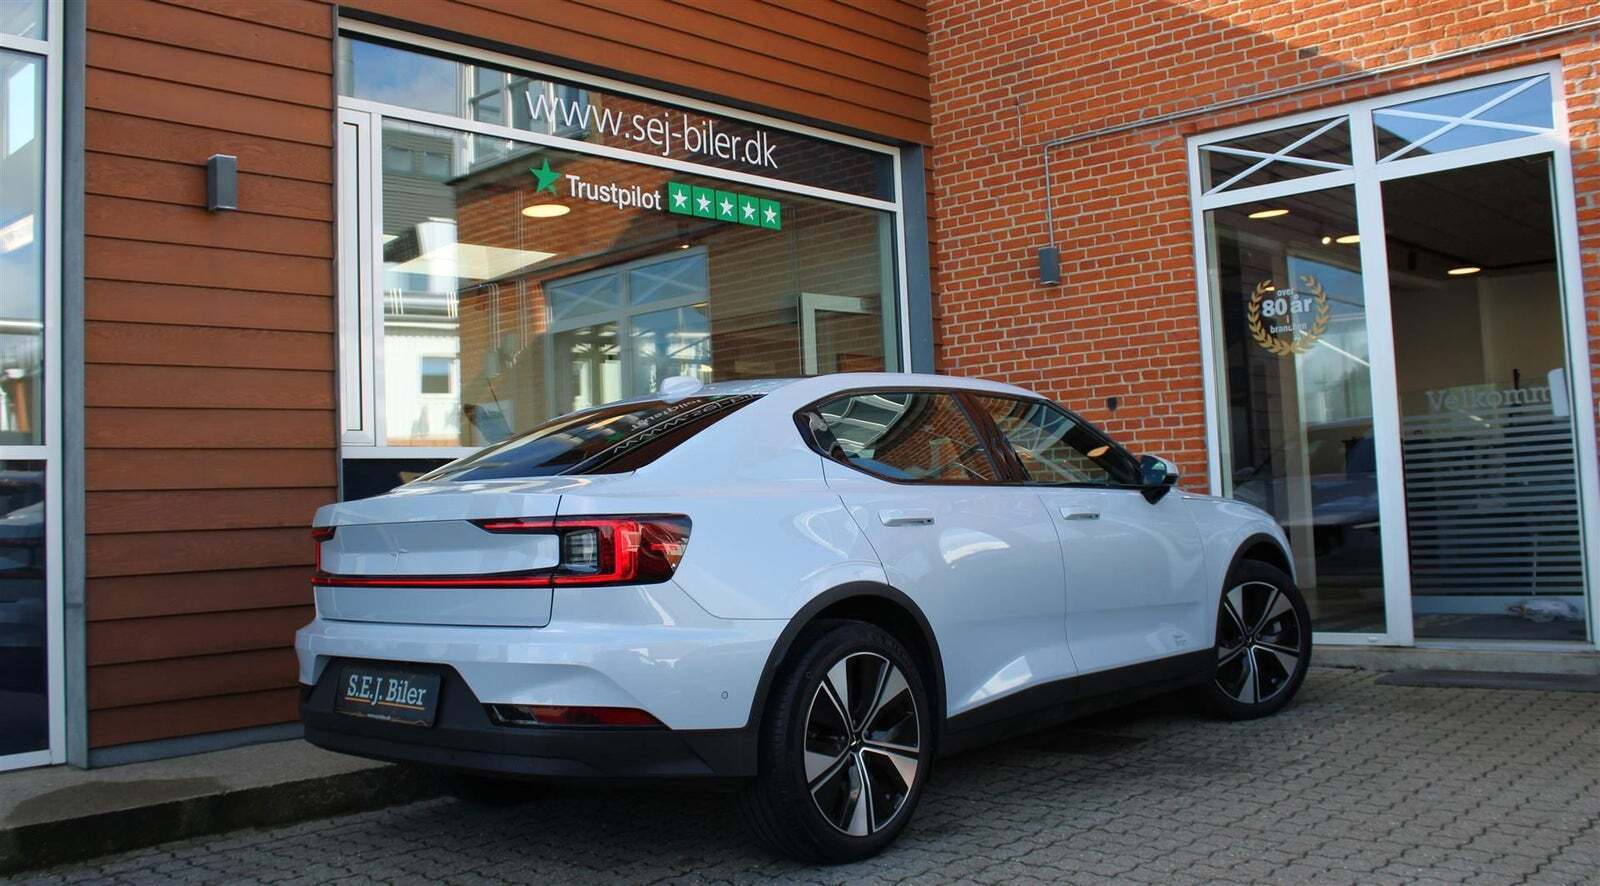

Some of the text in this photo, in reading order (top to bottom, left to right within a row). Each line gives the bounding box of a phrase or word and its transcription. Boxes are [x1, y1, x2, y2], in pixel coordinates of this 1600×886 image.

[526, 91, 778, 169] www.sej-biler.dk
[565, 174, 661, 211] Trustpilot
[1262, 294, 1312, 317] 80 år
[1277, 288, 1295, 297] over
[346, 674, 426, 706] S.E.J. Biler
